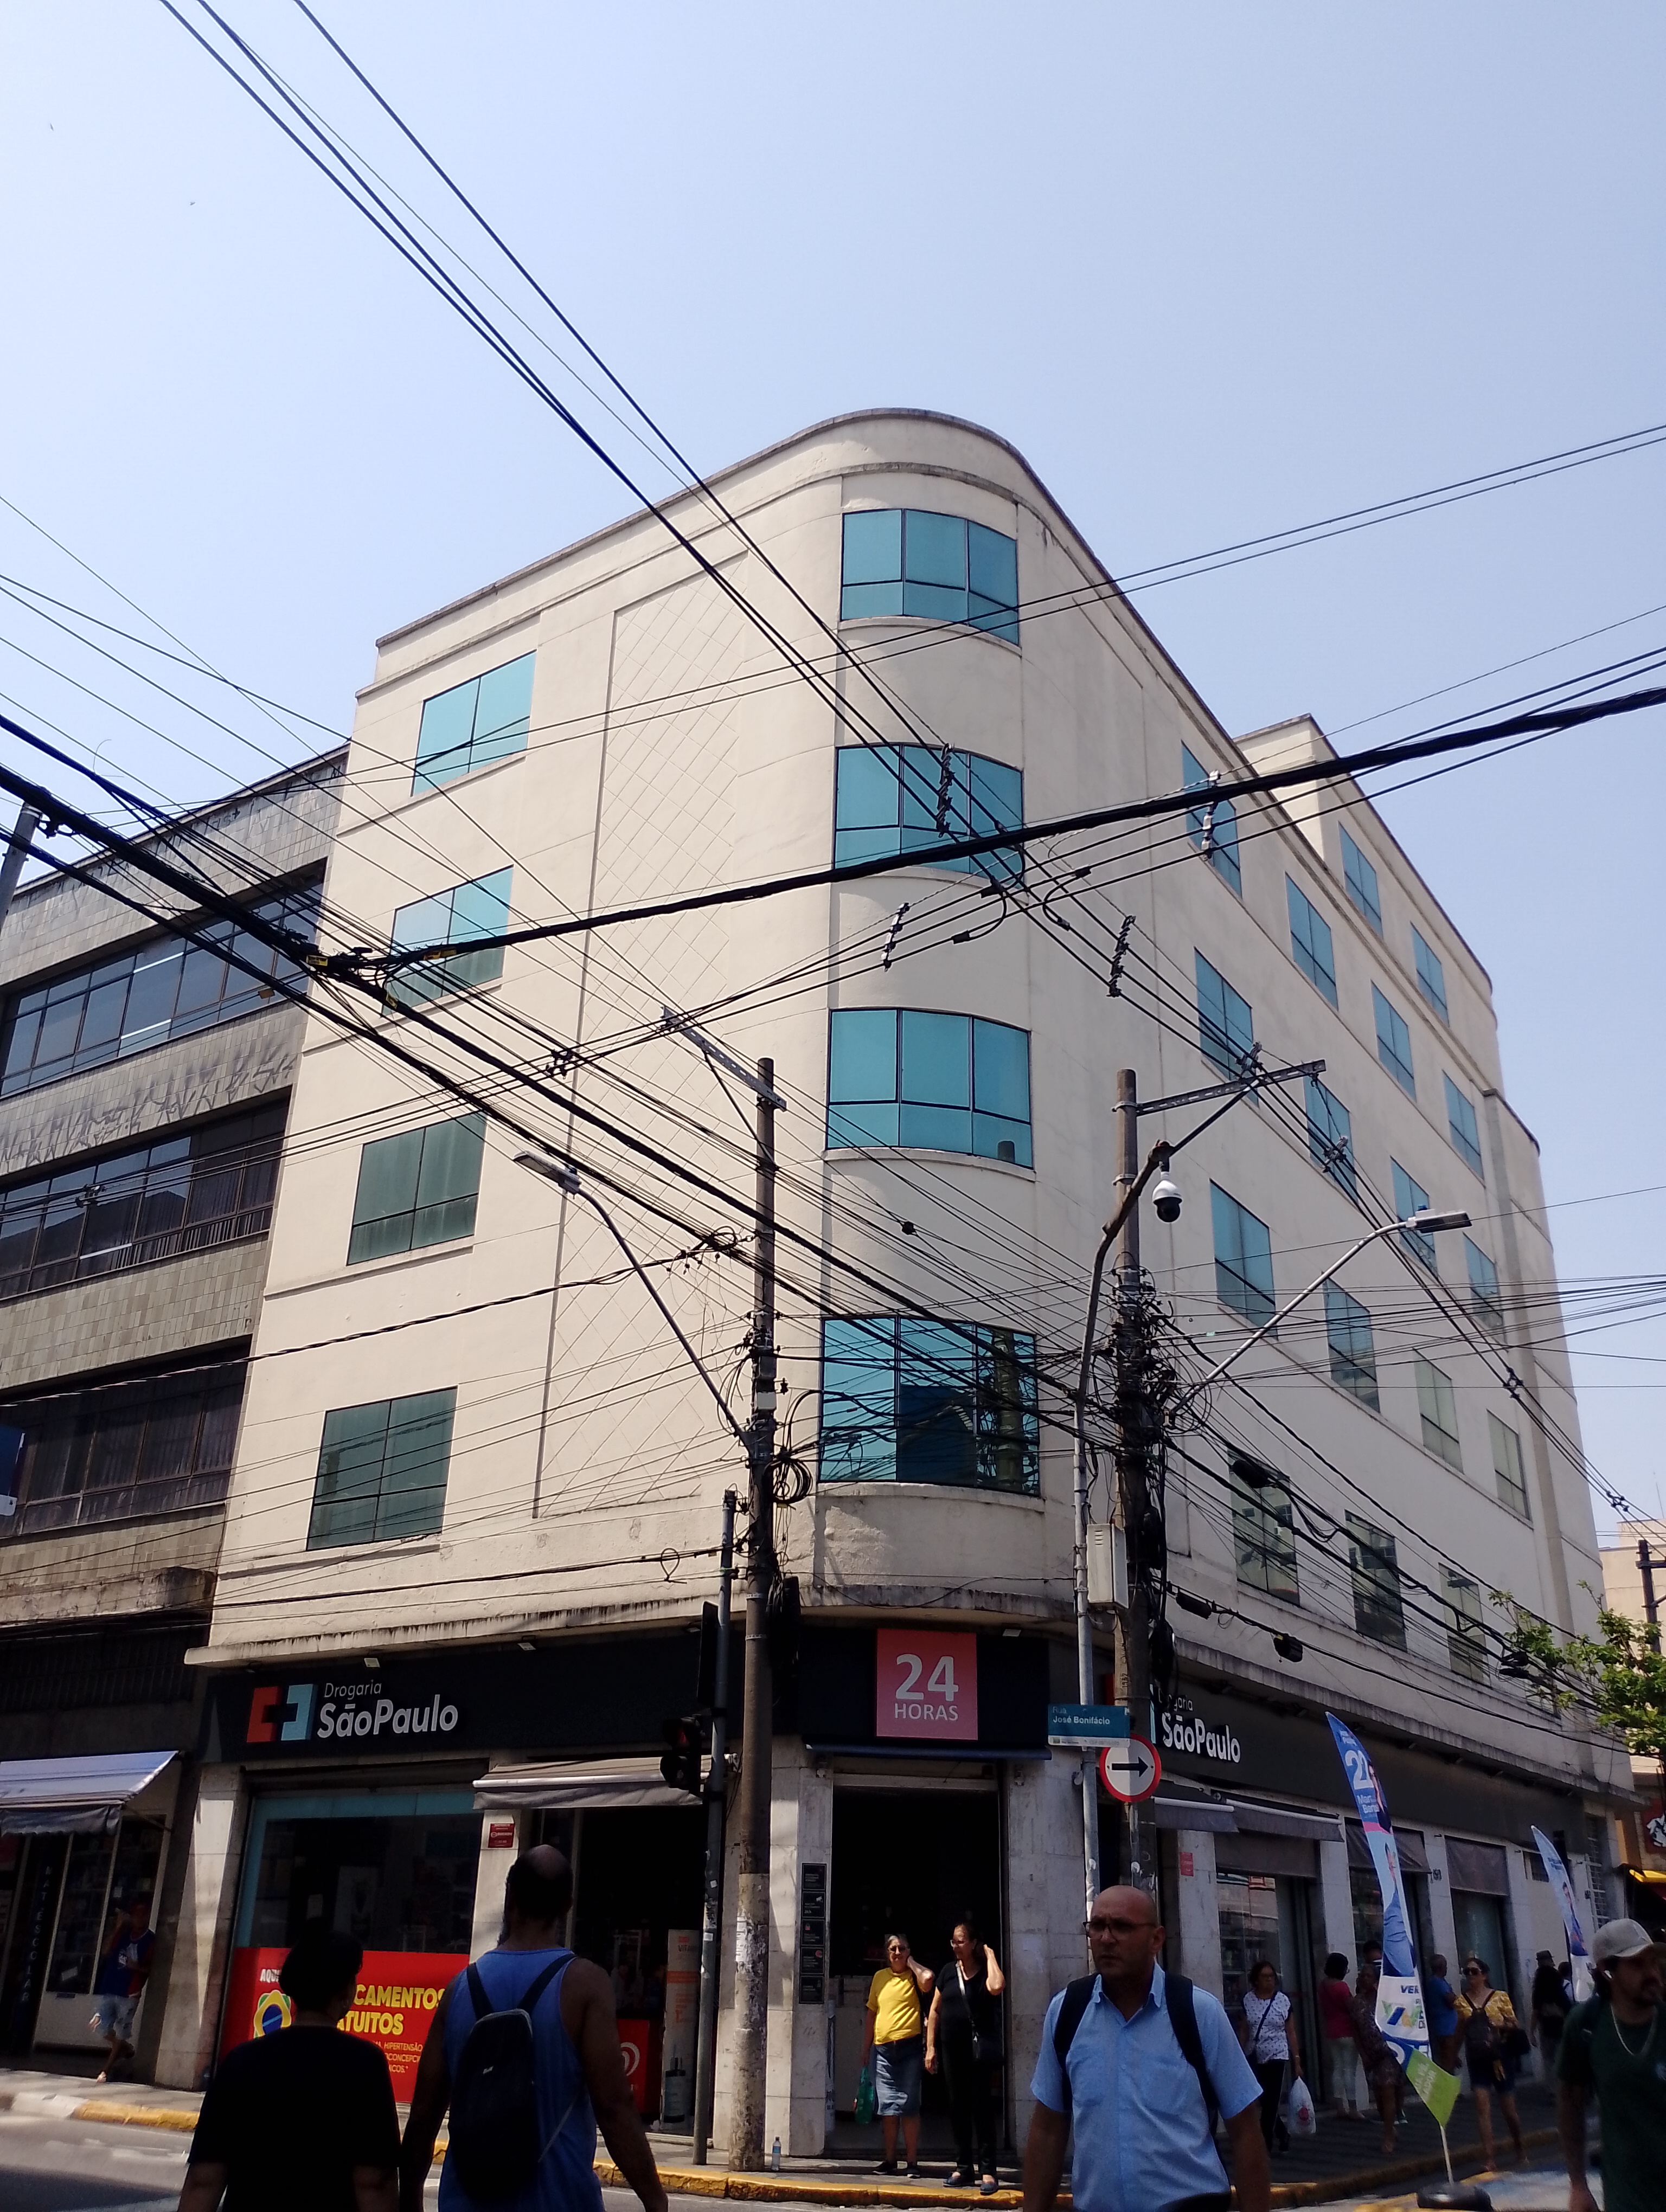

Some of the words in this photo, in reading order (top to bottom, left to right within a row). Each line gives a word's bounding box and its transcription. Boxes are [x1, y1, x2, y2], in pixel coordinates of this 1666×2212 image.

[324, 1680, 382, 1700] Drogaria
[895, 1654, 959, 1702] 24
[317, 1694, 458, 1739] SãoPaulo
[894, 1703, 958, 1721] HORAS
[1053, 1715, 1072, 1724] José
[1073, 1716, 1110, 1725] Bonifácio
[1162, 1712, 1241, 1764] SãoPaulo
